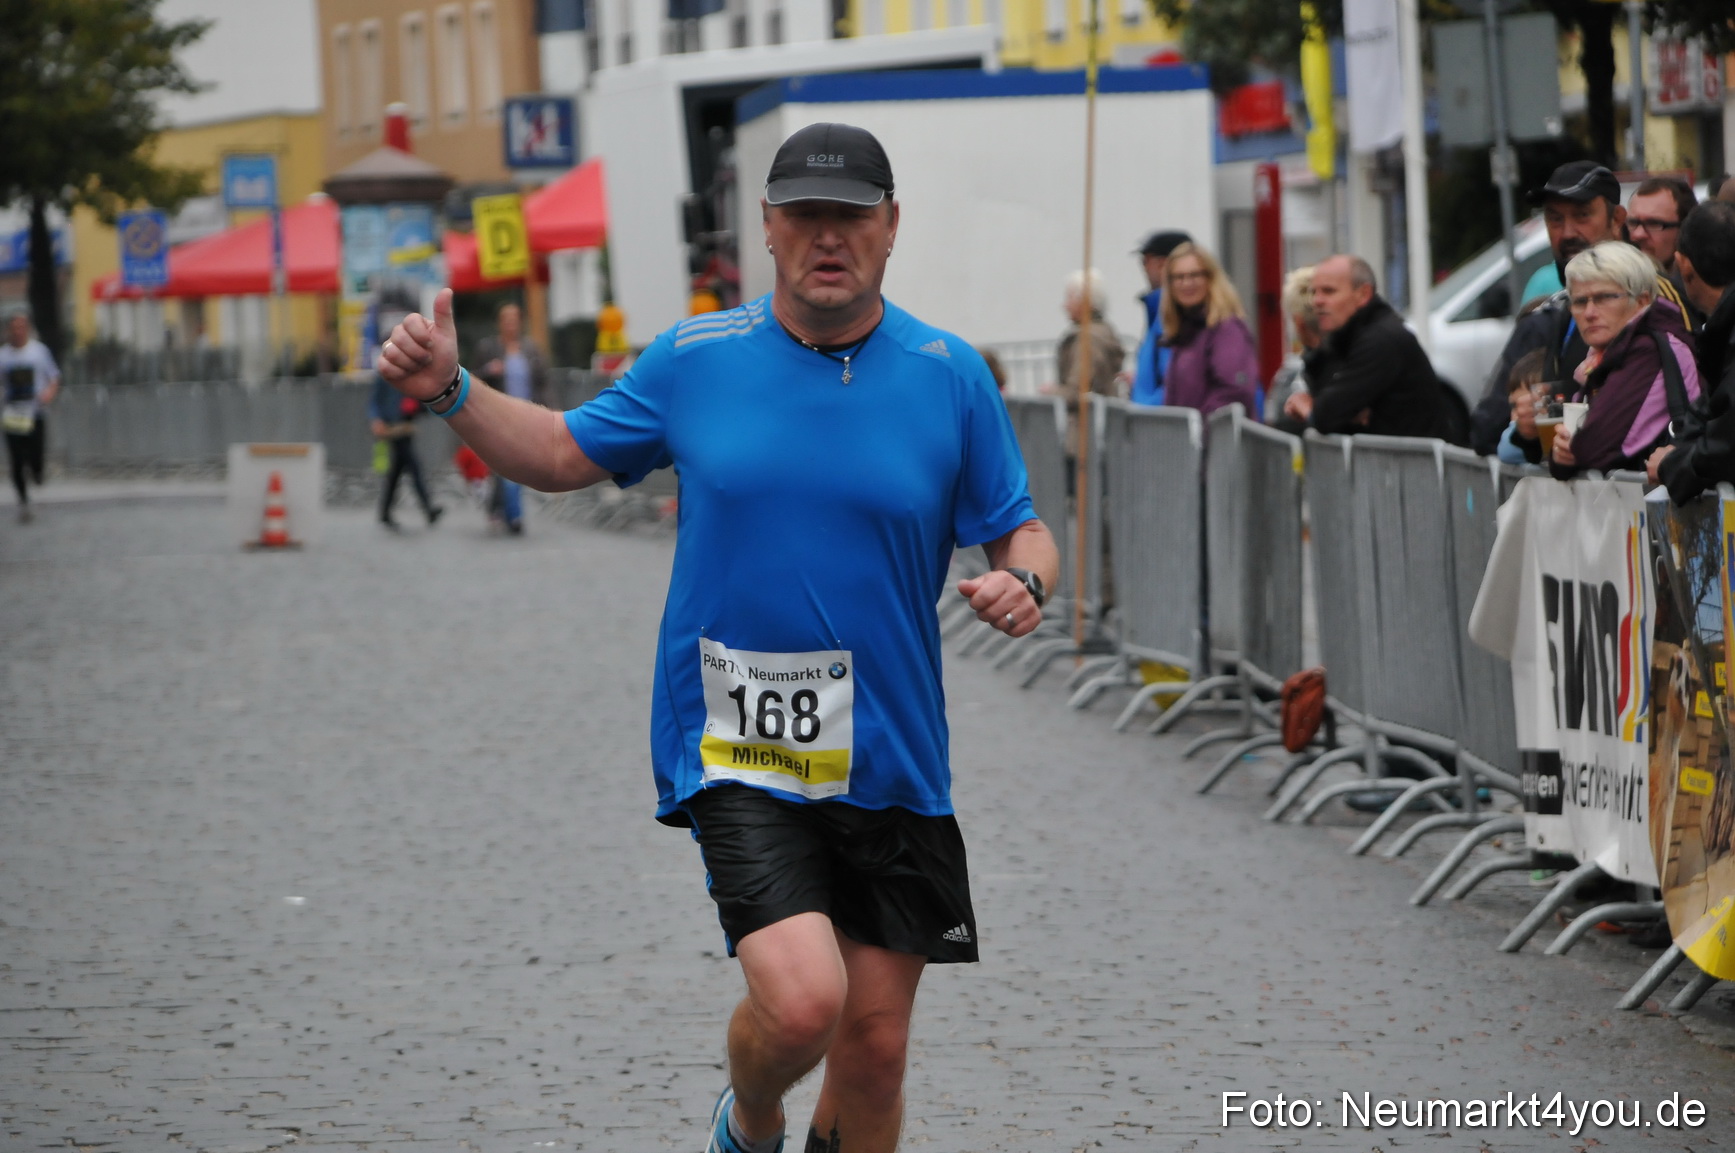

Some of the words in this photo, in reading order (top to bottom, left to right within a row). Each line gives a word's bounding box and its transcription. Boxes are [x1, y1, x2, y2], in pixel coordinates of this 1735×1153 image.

[806, 154, 845, 163] GORE
[748, 666, 822, 682] Neumarkt
[727, 684, 821, 743] 168
[732, 746, 810, 779] Michael
[942, 932, 971, 943] adidas
